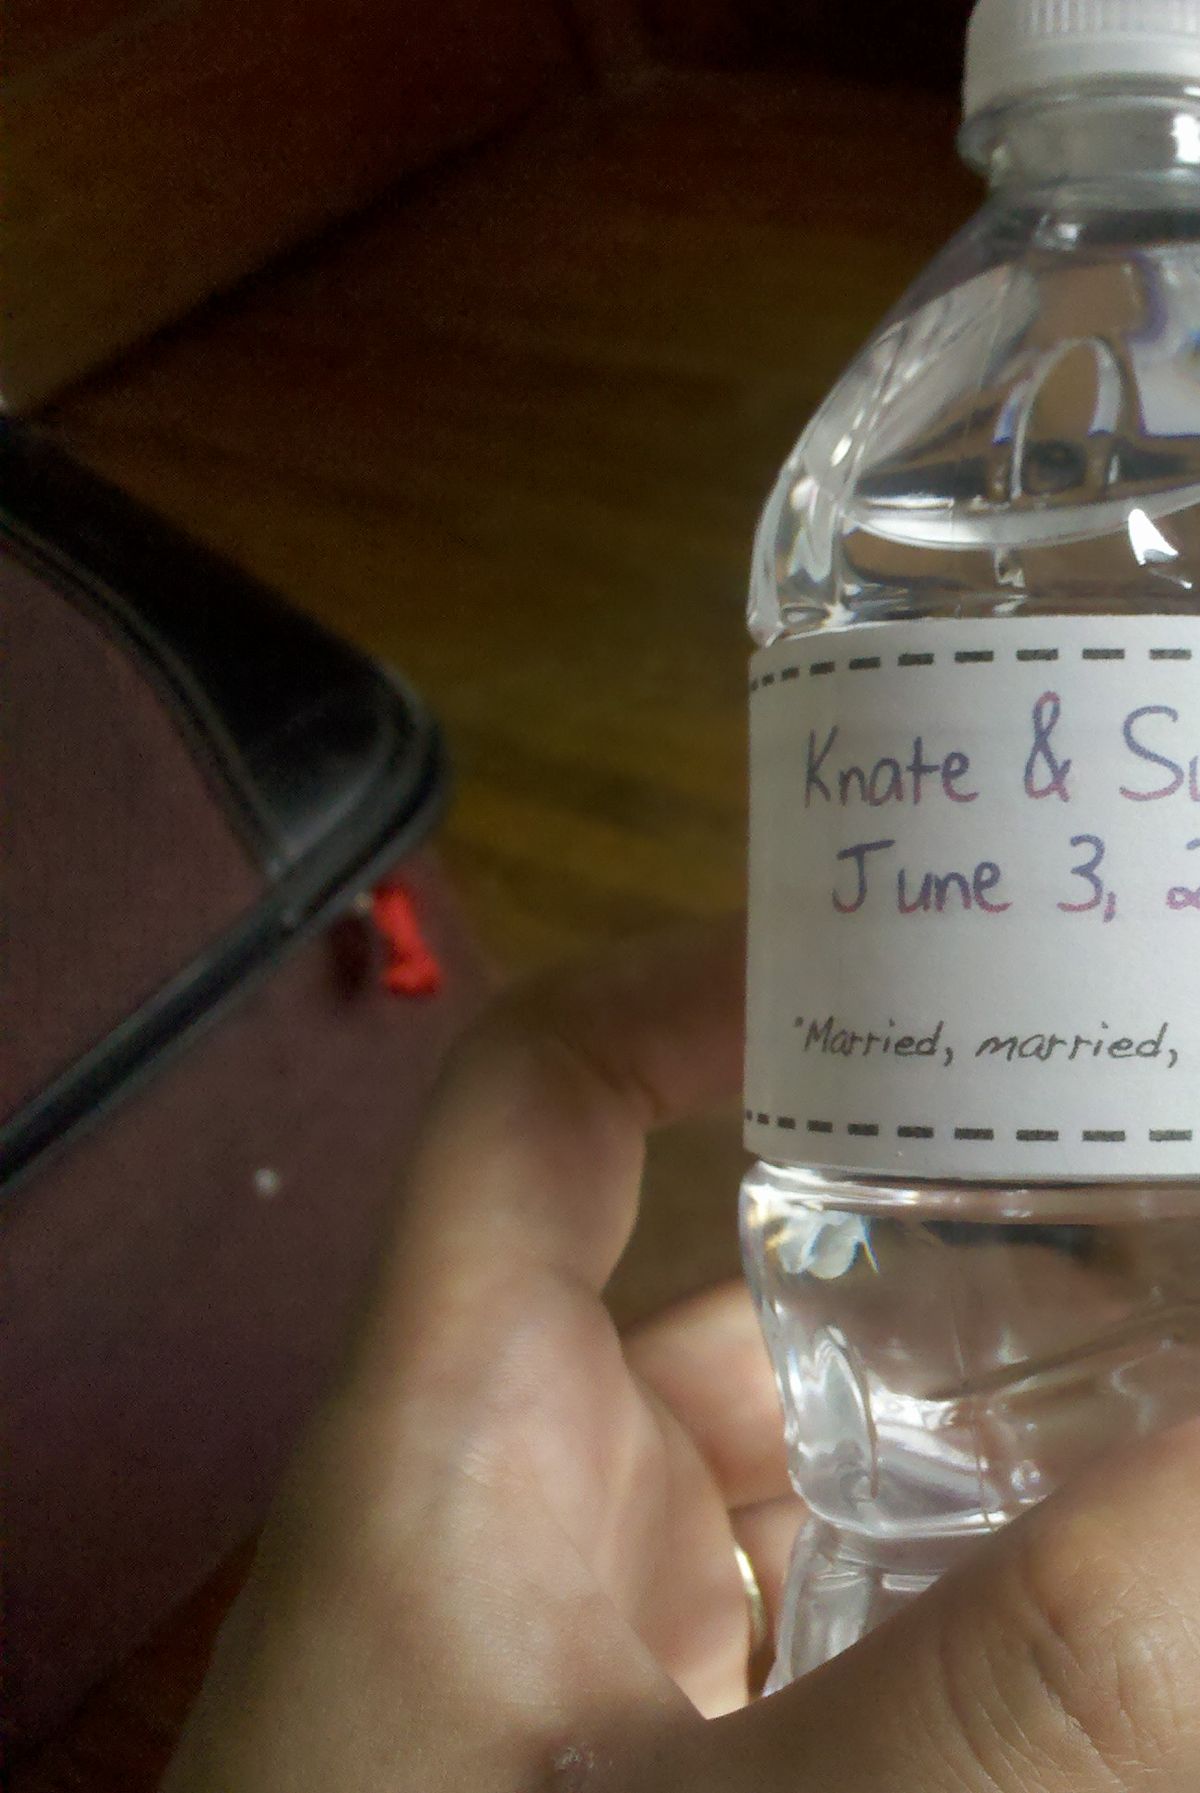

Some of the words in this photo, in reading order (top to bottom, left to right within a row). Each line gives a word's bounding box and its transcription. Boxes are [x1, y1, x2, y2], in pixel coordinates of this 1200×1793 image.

[804, 725, 979, 809] Knate
[1024, 690, 1072, 803] &
[832, 839, 1013, 914] June
[1056, 834, 1116, 923] 3,
[975, 1021, 1178, 1068] married,
